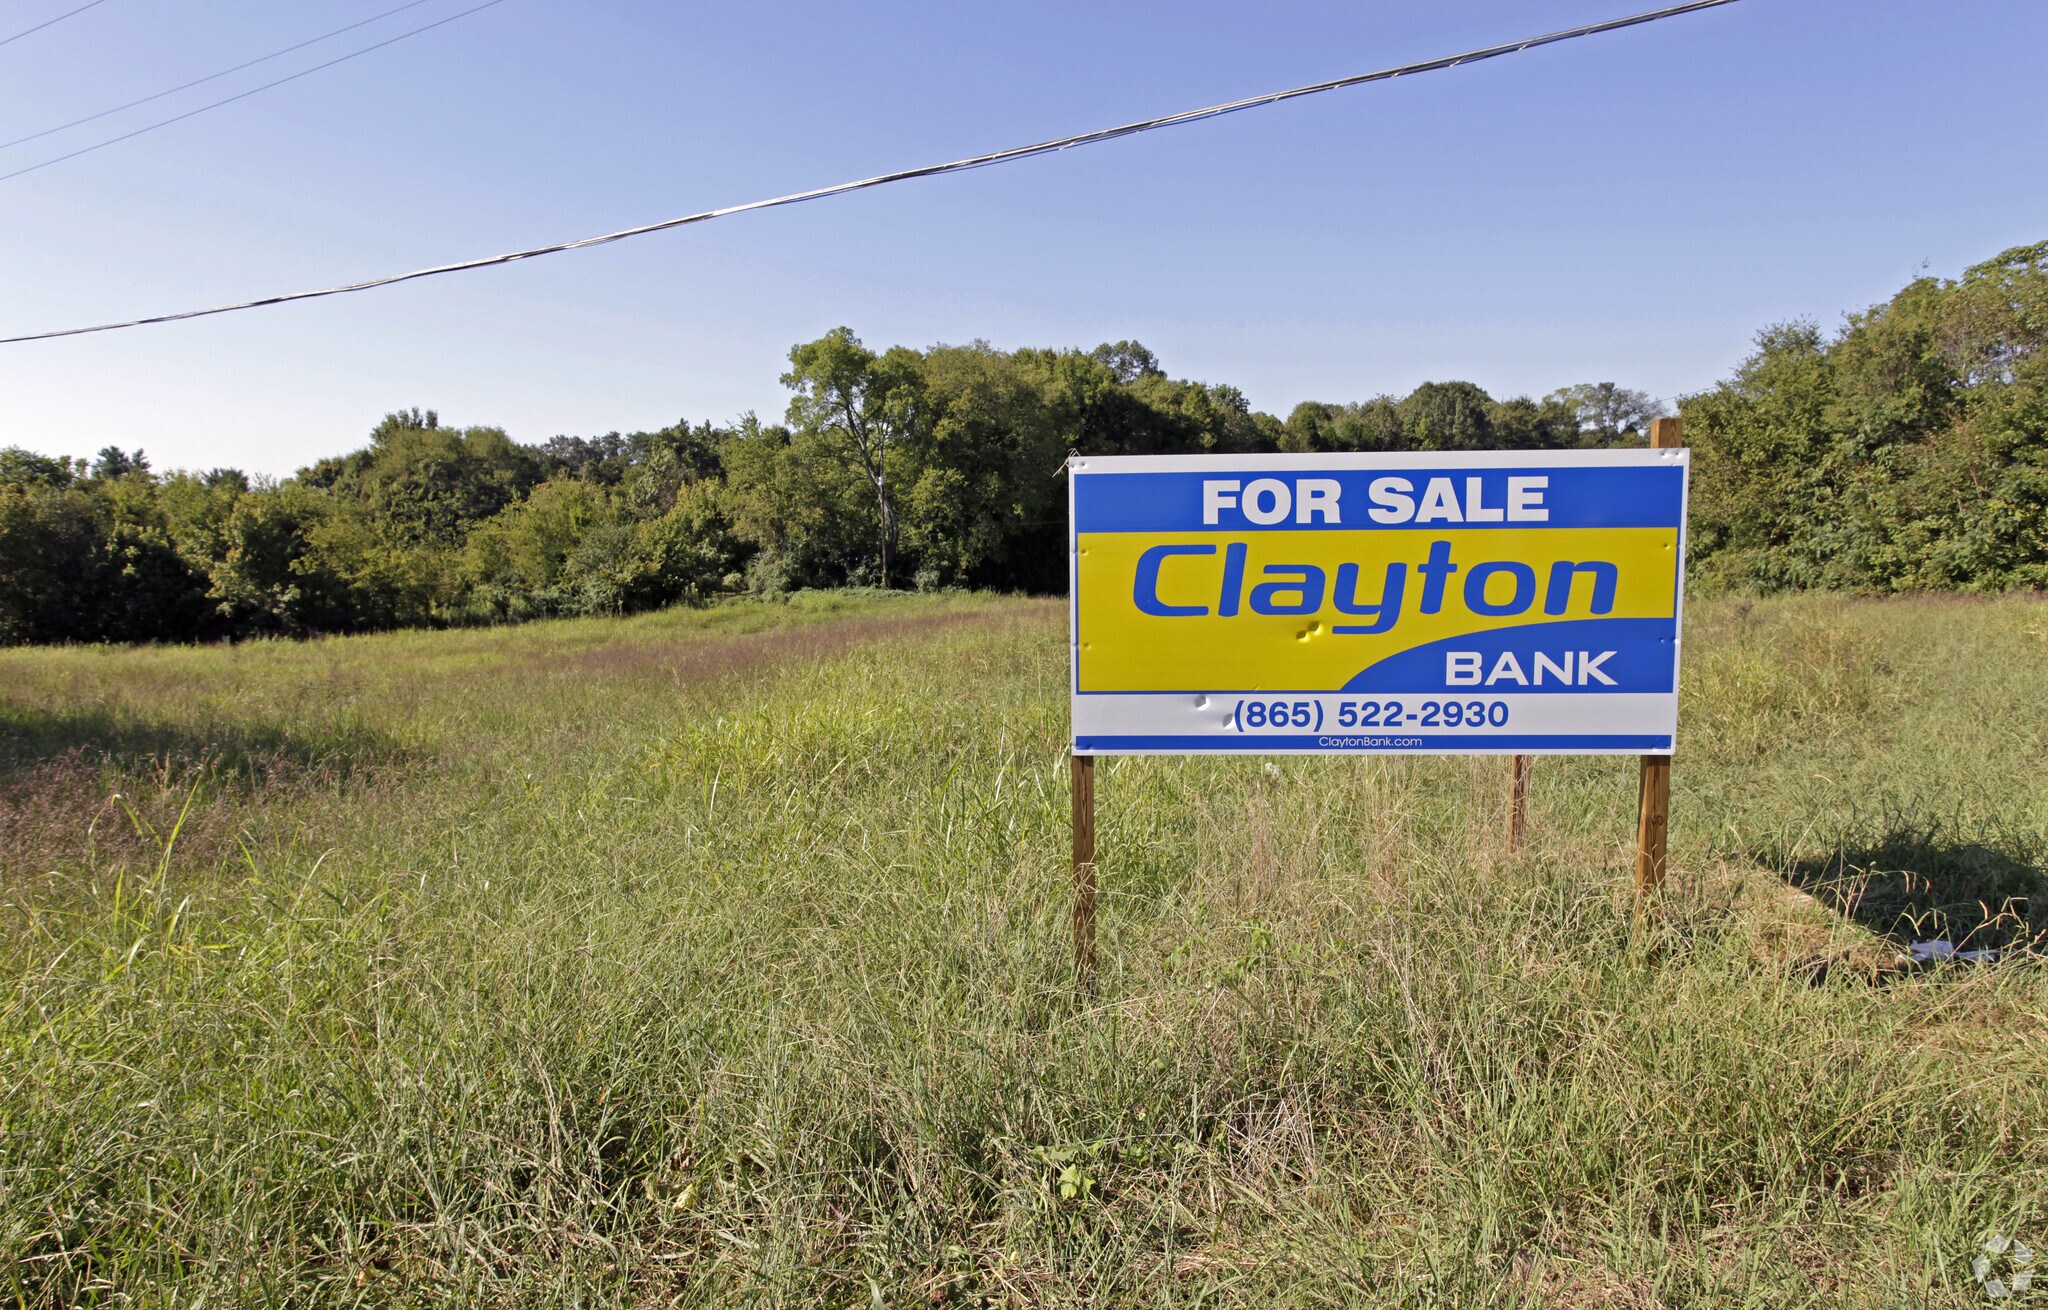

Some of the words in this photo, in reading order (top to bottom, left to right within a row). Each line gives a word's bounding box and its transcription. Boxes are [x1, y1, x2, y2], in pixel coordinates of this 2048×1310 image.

[1203, 478, 1342, 526] FOR
[1367, 475, 1551, 525] SALE
[1133, 540, 1619, 635] Clayton
[1445, 650, 1619, 686] BANK
[1234, 699, 1324, 733] (865)
[1338, 700, 1510, 729] 522-2930
[1318, 736, 1423, 748] ClaytonBank.com
